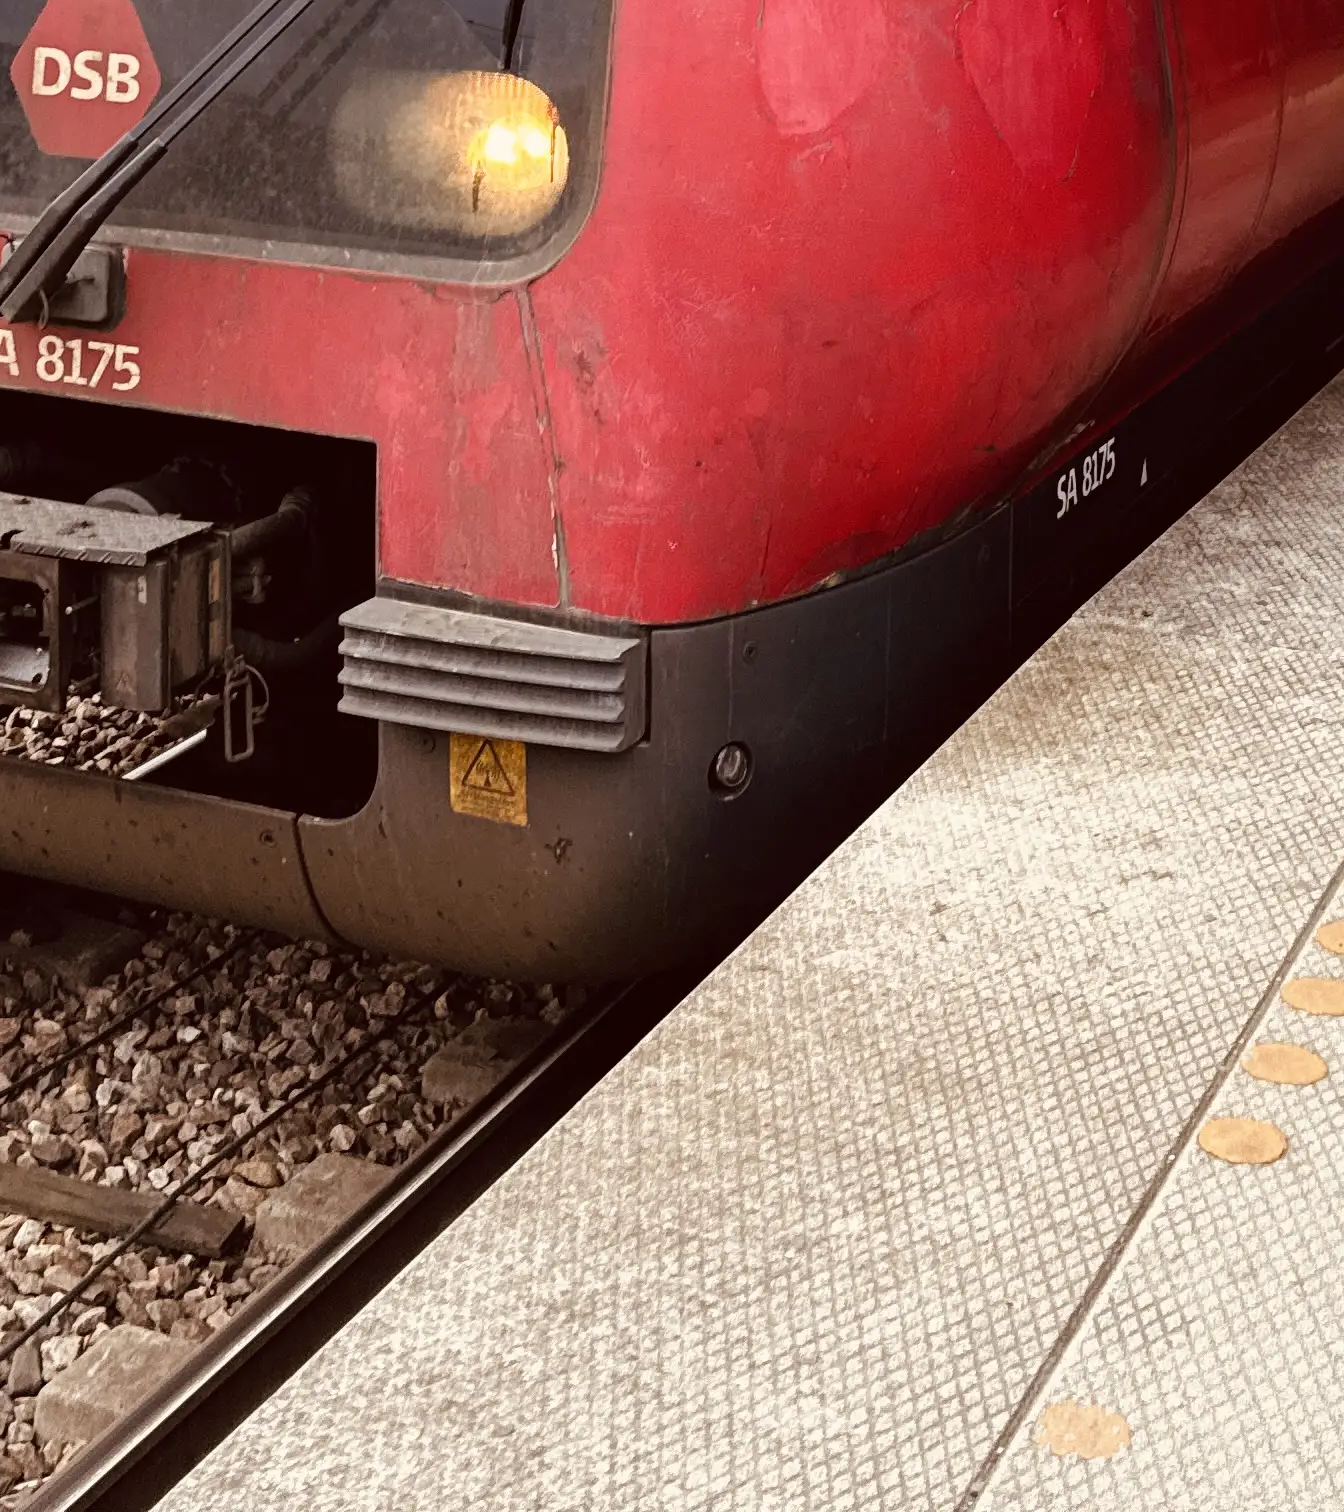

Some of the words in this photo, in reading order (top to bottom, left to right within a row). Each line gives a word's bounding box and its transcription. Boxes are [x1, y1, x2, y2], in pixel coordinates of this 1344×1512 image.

[31, 46, 141, 104] DSB
[36, 334, 142, 391] 8175
[1057, 467, 1078, 519] SA
[1082, 437, 1116, 497] 8175
